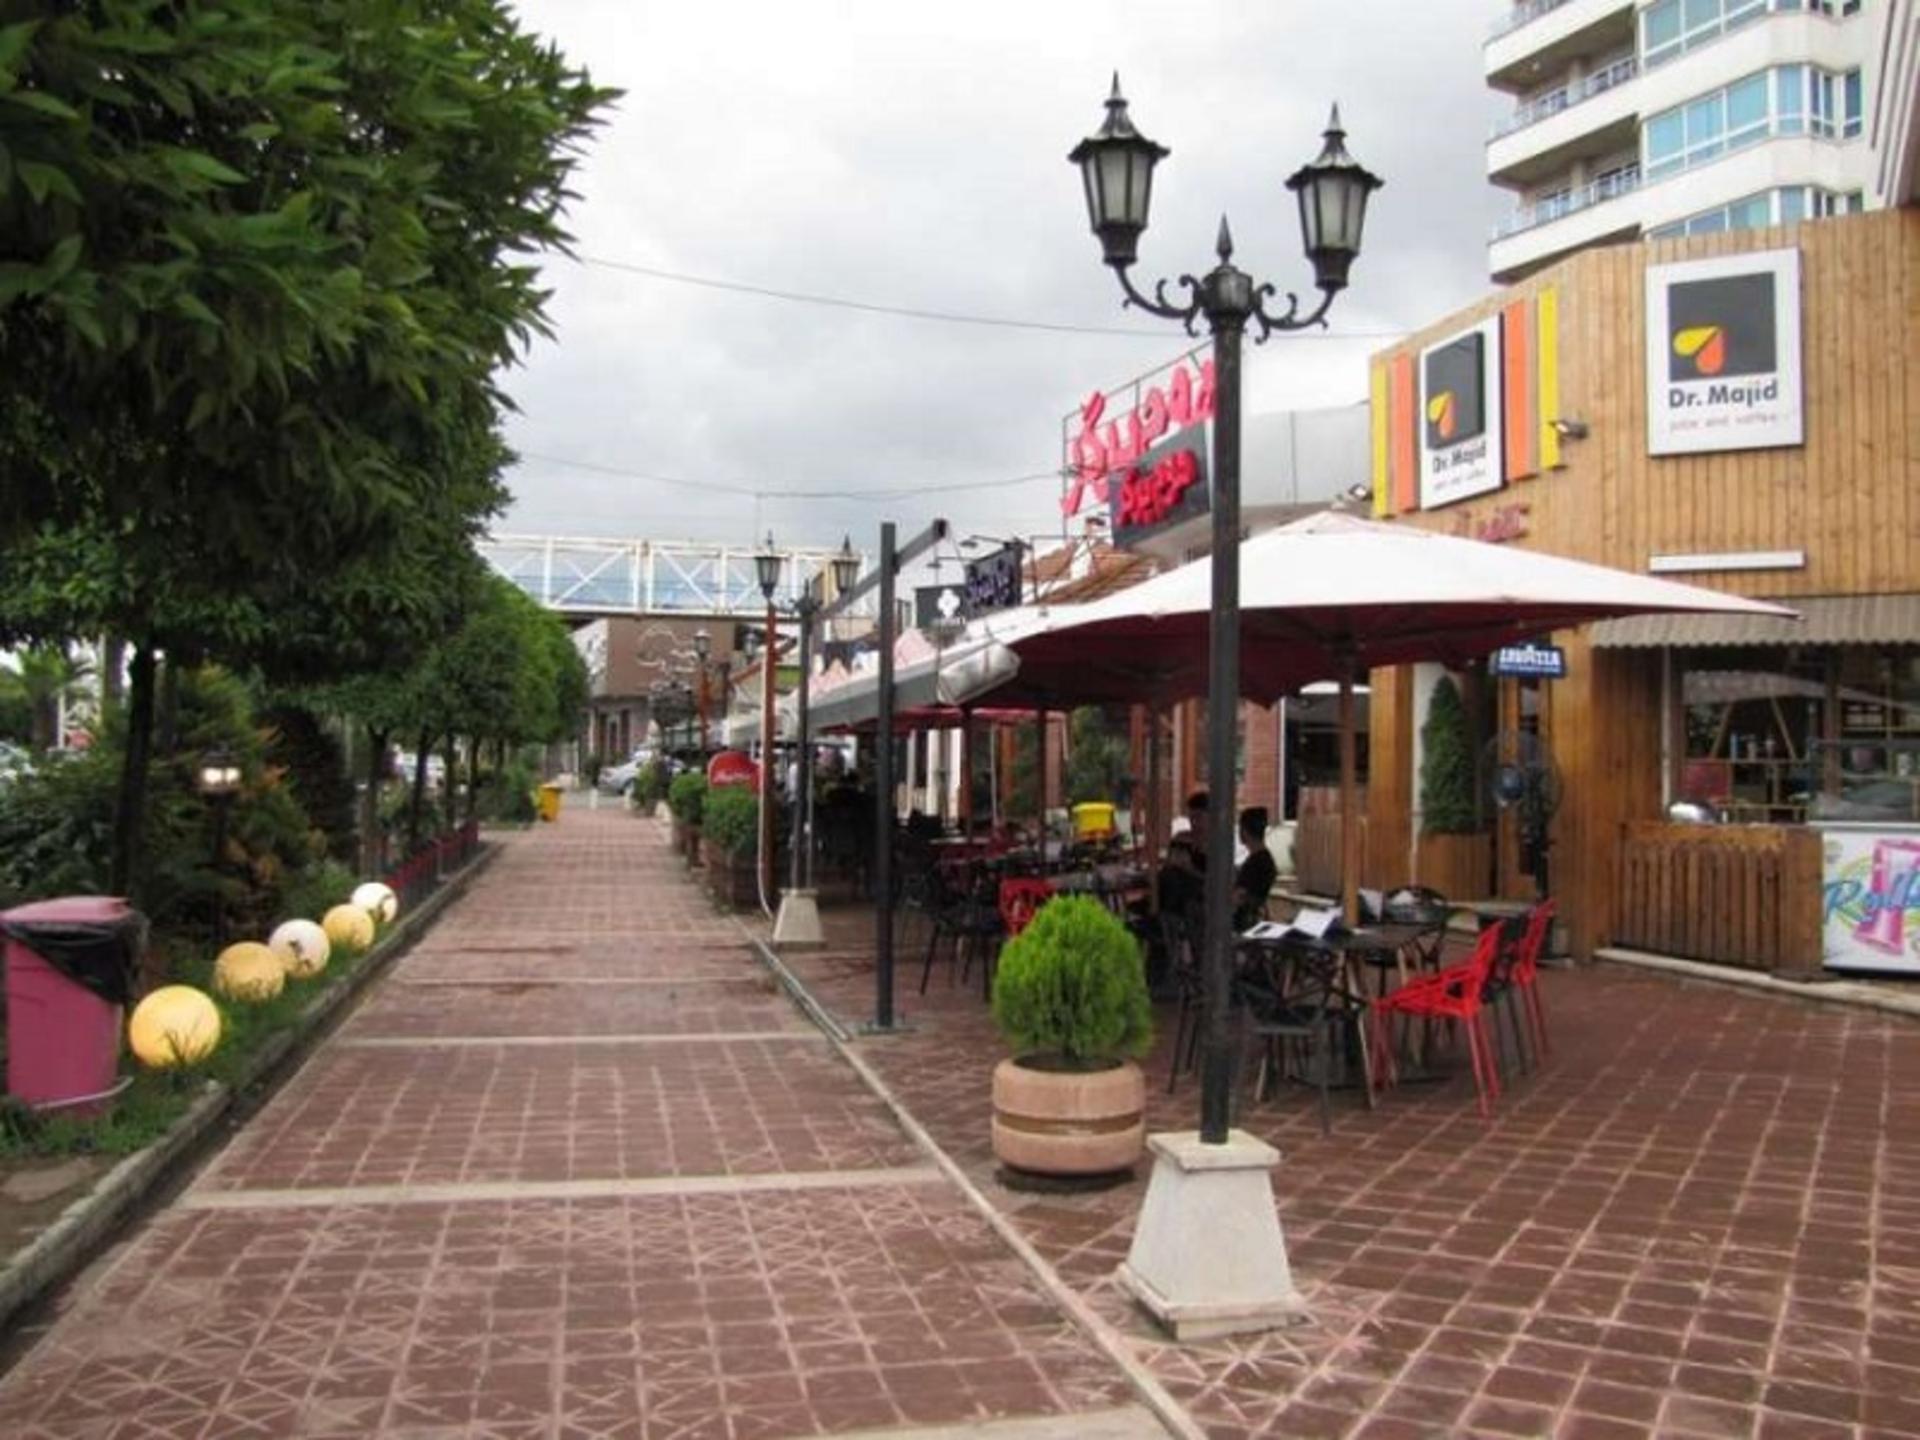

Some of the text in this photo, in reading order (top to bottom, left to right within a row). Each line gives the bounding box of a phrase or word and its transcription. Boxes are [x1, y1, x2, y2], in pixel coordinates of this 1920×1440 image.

[1669, 378, 1779, 409] Dr. Majid
[1451, 439, 1487, 467] Majid
